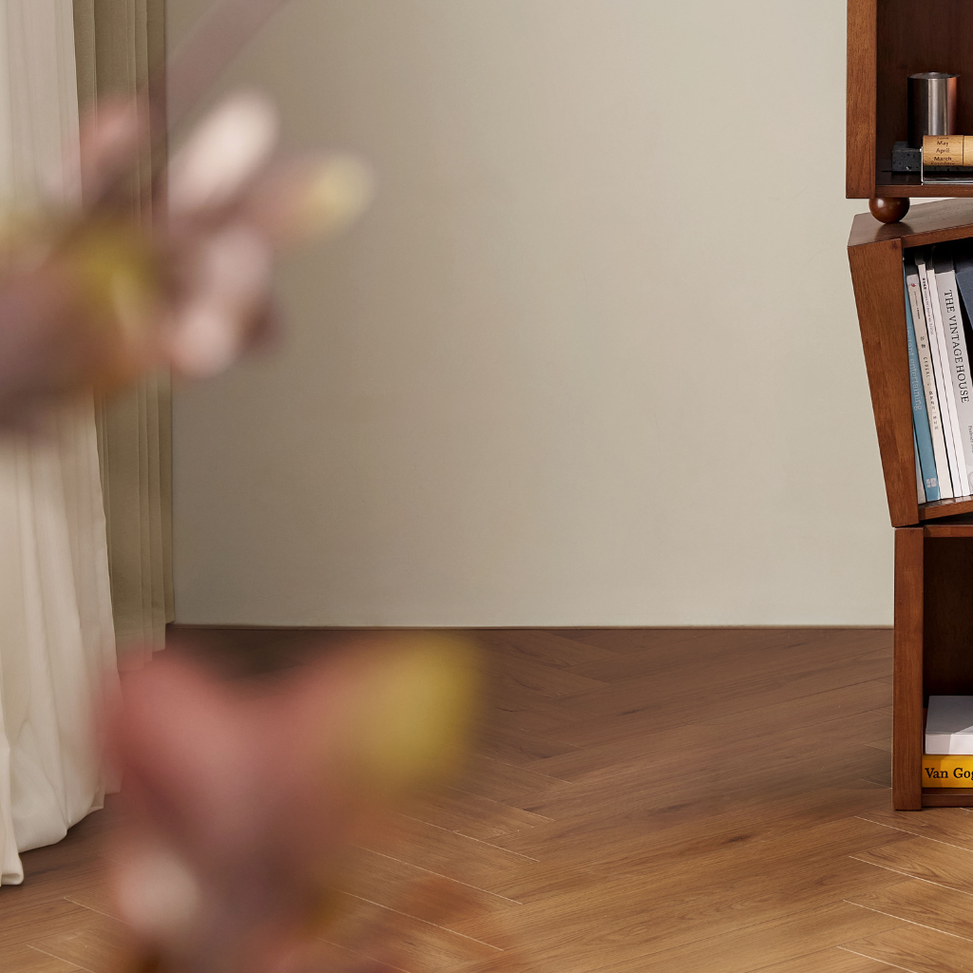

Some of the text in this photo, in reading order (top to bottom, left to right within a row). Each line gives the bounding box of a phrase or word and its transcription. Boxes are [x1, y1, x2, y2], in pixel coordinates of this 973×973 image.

[944, 289, 969, 403] THE VINTAGE HOUSE
[909, 358, 923, 411] entertaining
[924, 767, 948, 778] Van
